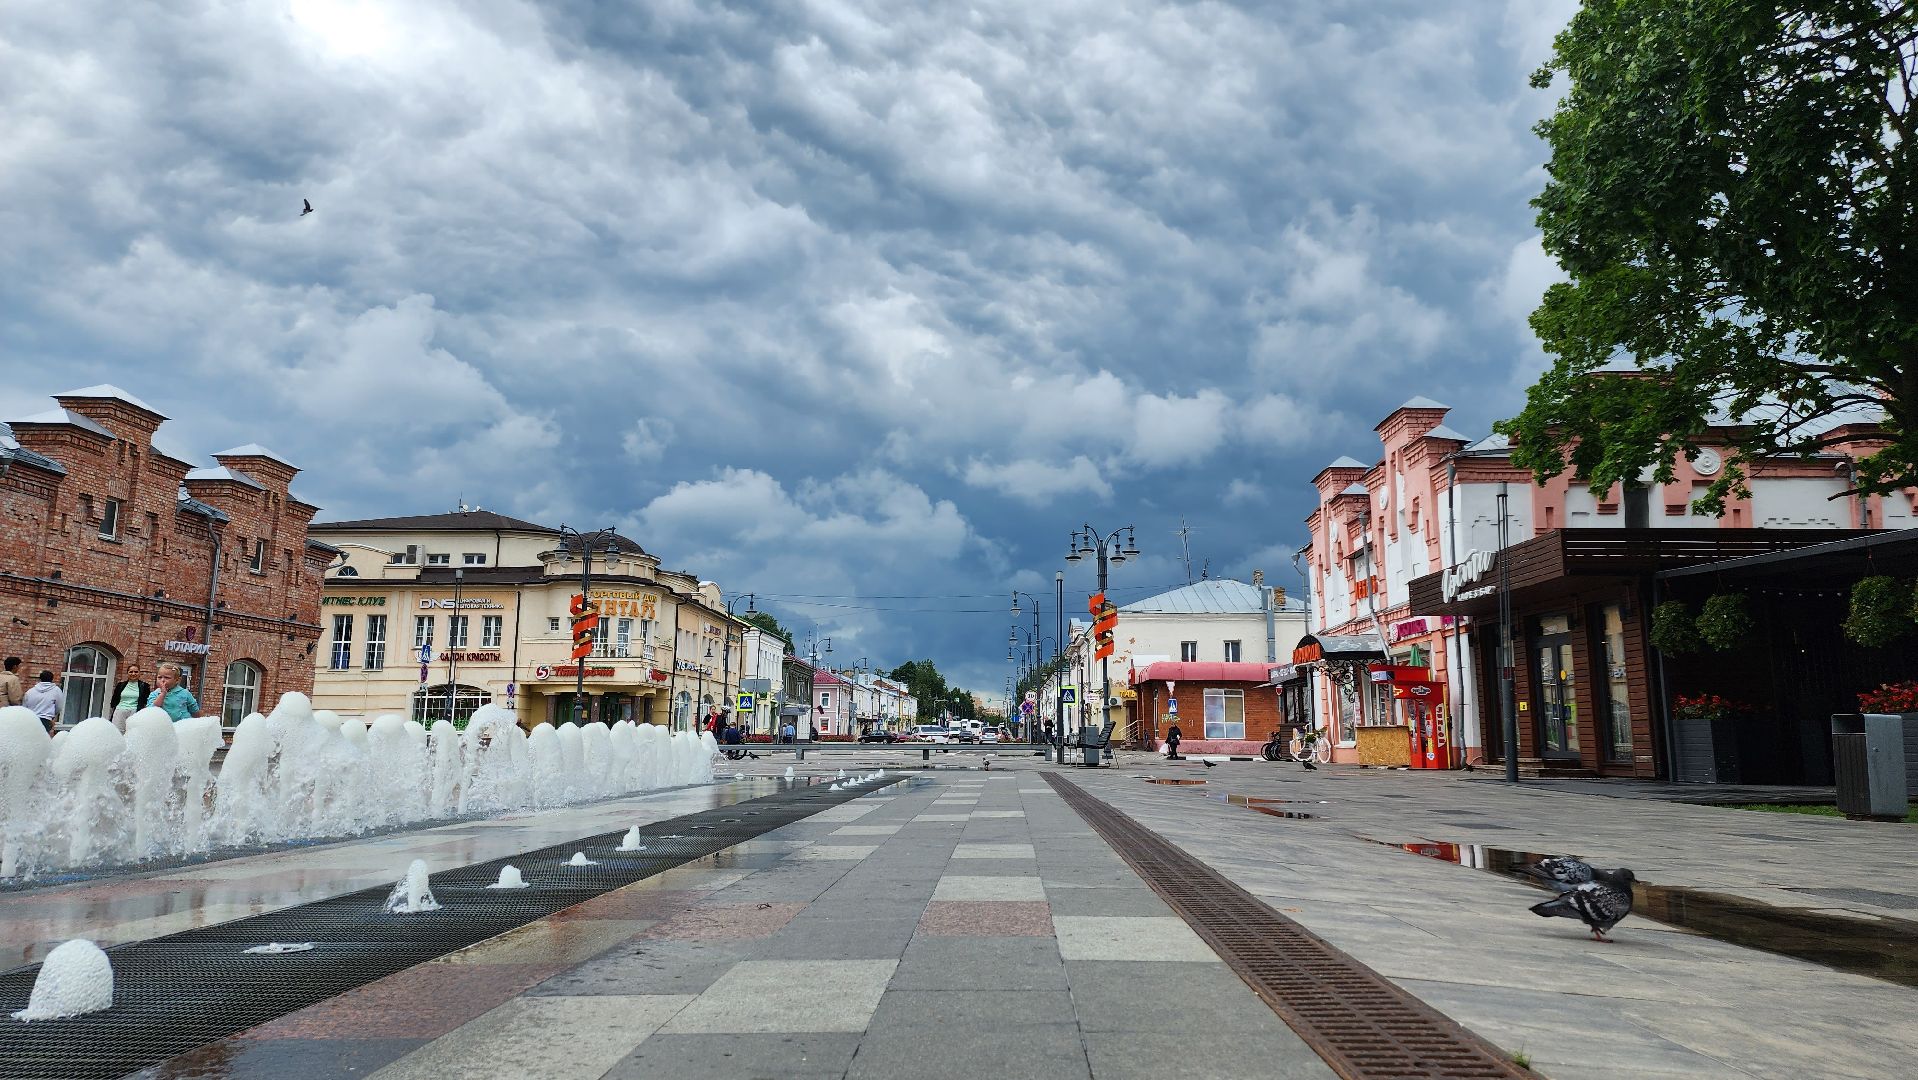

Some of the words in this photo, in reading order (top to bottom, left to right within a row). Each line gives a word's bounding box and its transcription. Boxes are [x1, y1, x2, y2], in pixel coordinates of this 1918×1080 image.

[588, 590, 640, 600] ТОРГОВЫЙ
[322, 596, 355, 606] ИТНЕС
[358, 596, 386, 606] КЛУБ
[420, 599, 456, 609] DNS
[165, 640, 212, 655] НОТАРИУС
[466, 653, 501, 661] КРАСОТЫ
